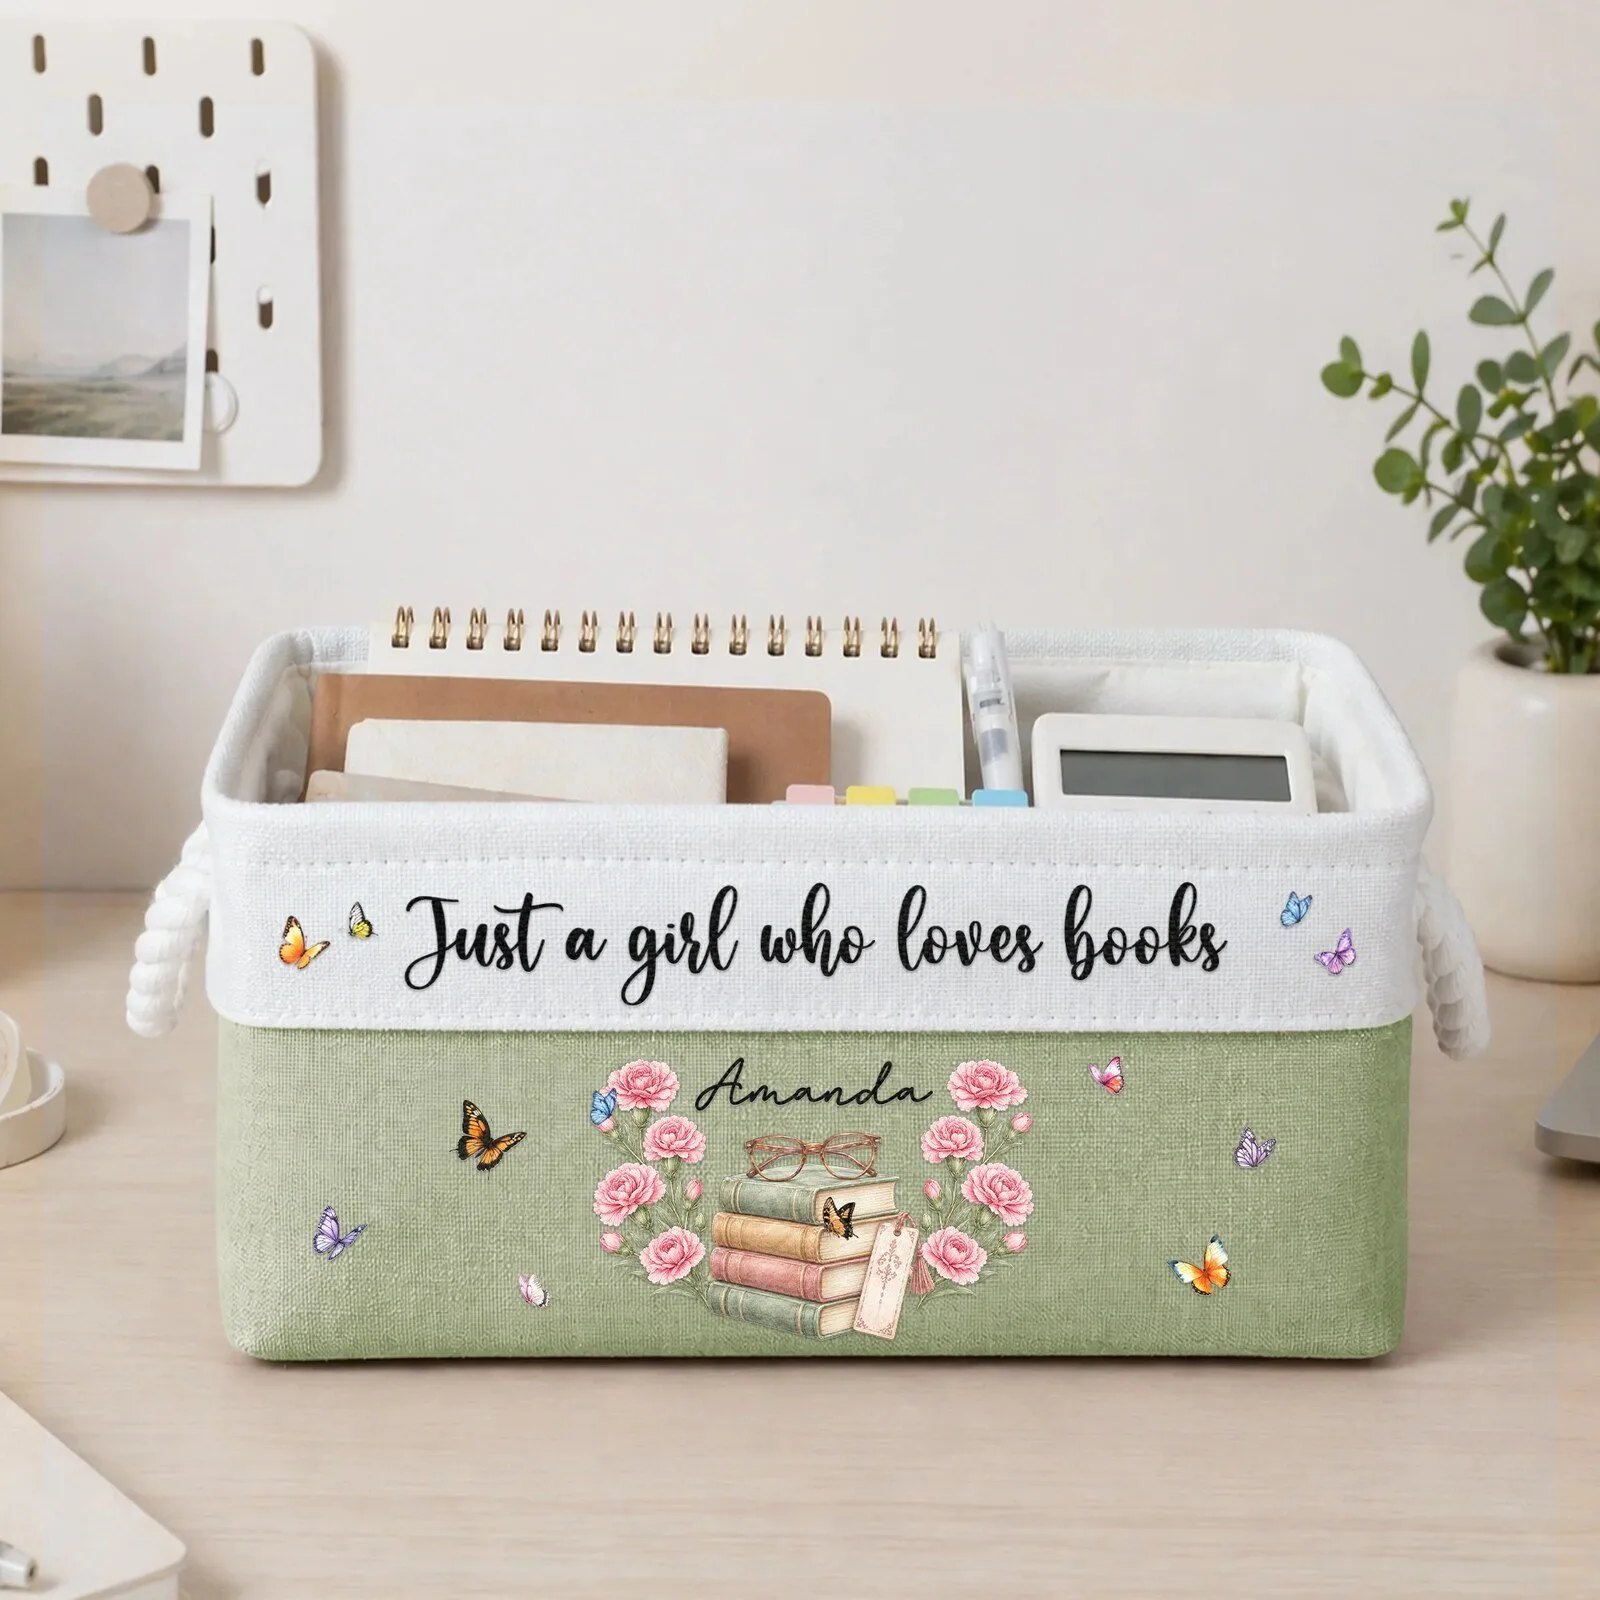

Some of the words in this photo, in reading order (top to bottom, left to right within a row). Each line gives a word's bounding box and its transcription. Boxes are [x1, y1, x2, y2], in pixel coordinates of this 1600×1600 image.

[405, 892, 564, 991] Just
[565, 927, 608, 961] a
[620, 885, 739, 1006] girl
[760, 882, 876, 978] who
[897, 884, 1044, 973] loves
[1064, 881, 1228, 981] books
[694, 1057, 934, 1112] Amanda
